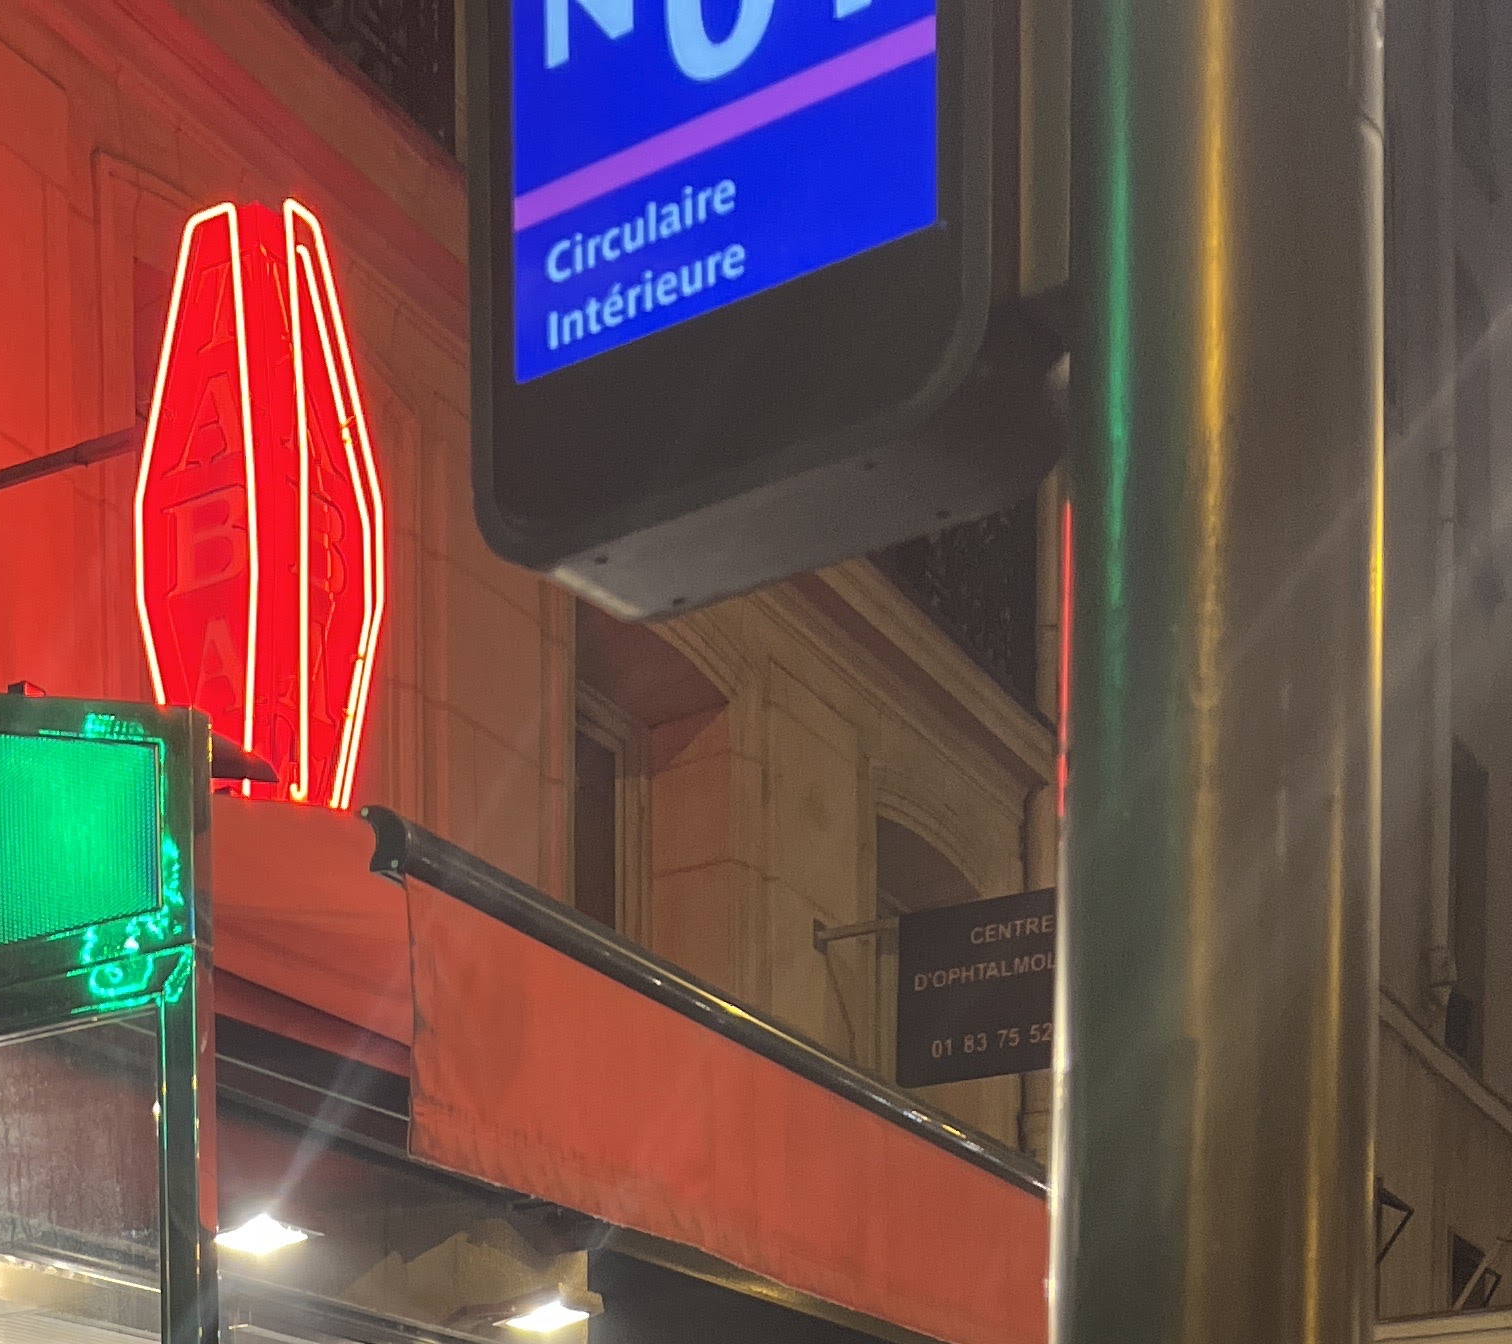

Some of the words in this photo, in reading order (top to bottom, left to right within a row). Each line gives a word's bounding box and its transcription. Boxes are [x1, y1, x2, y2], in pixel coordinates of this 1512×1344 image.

[544, 178, 737, 283] Circulaire
[546, 242, 746, 350] Intérieure
[970, 914, 1055, 944] CENTRE
[931, 1038, 952, 1058] 01
[963, 1033, 987, 1053] 83
[997, 1028, 1021, 1048] 75
